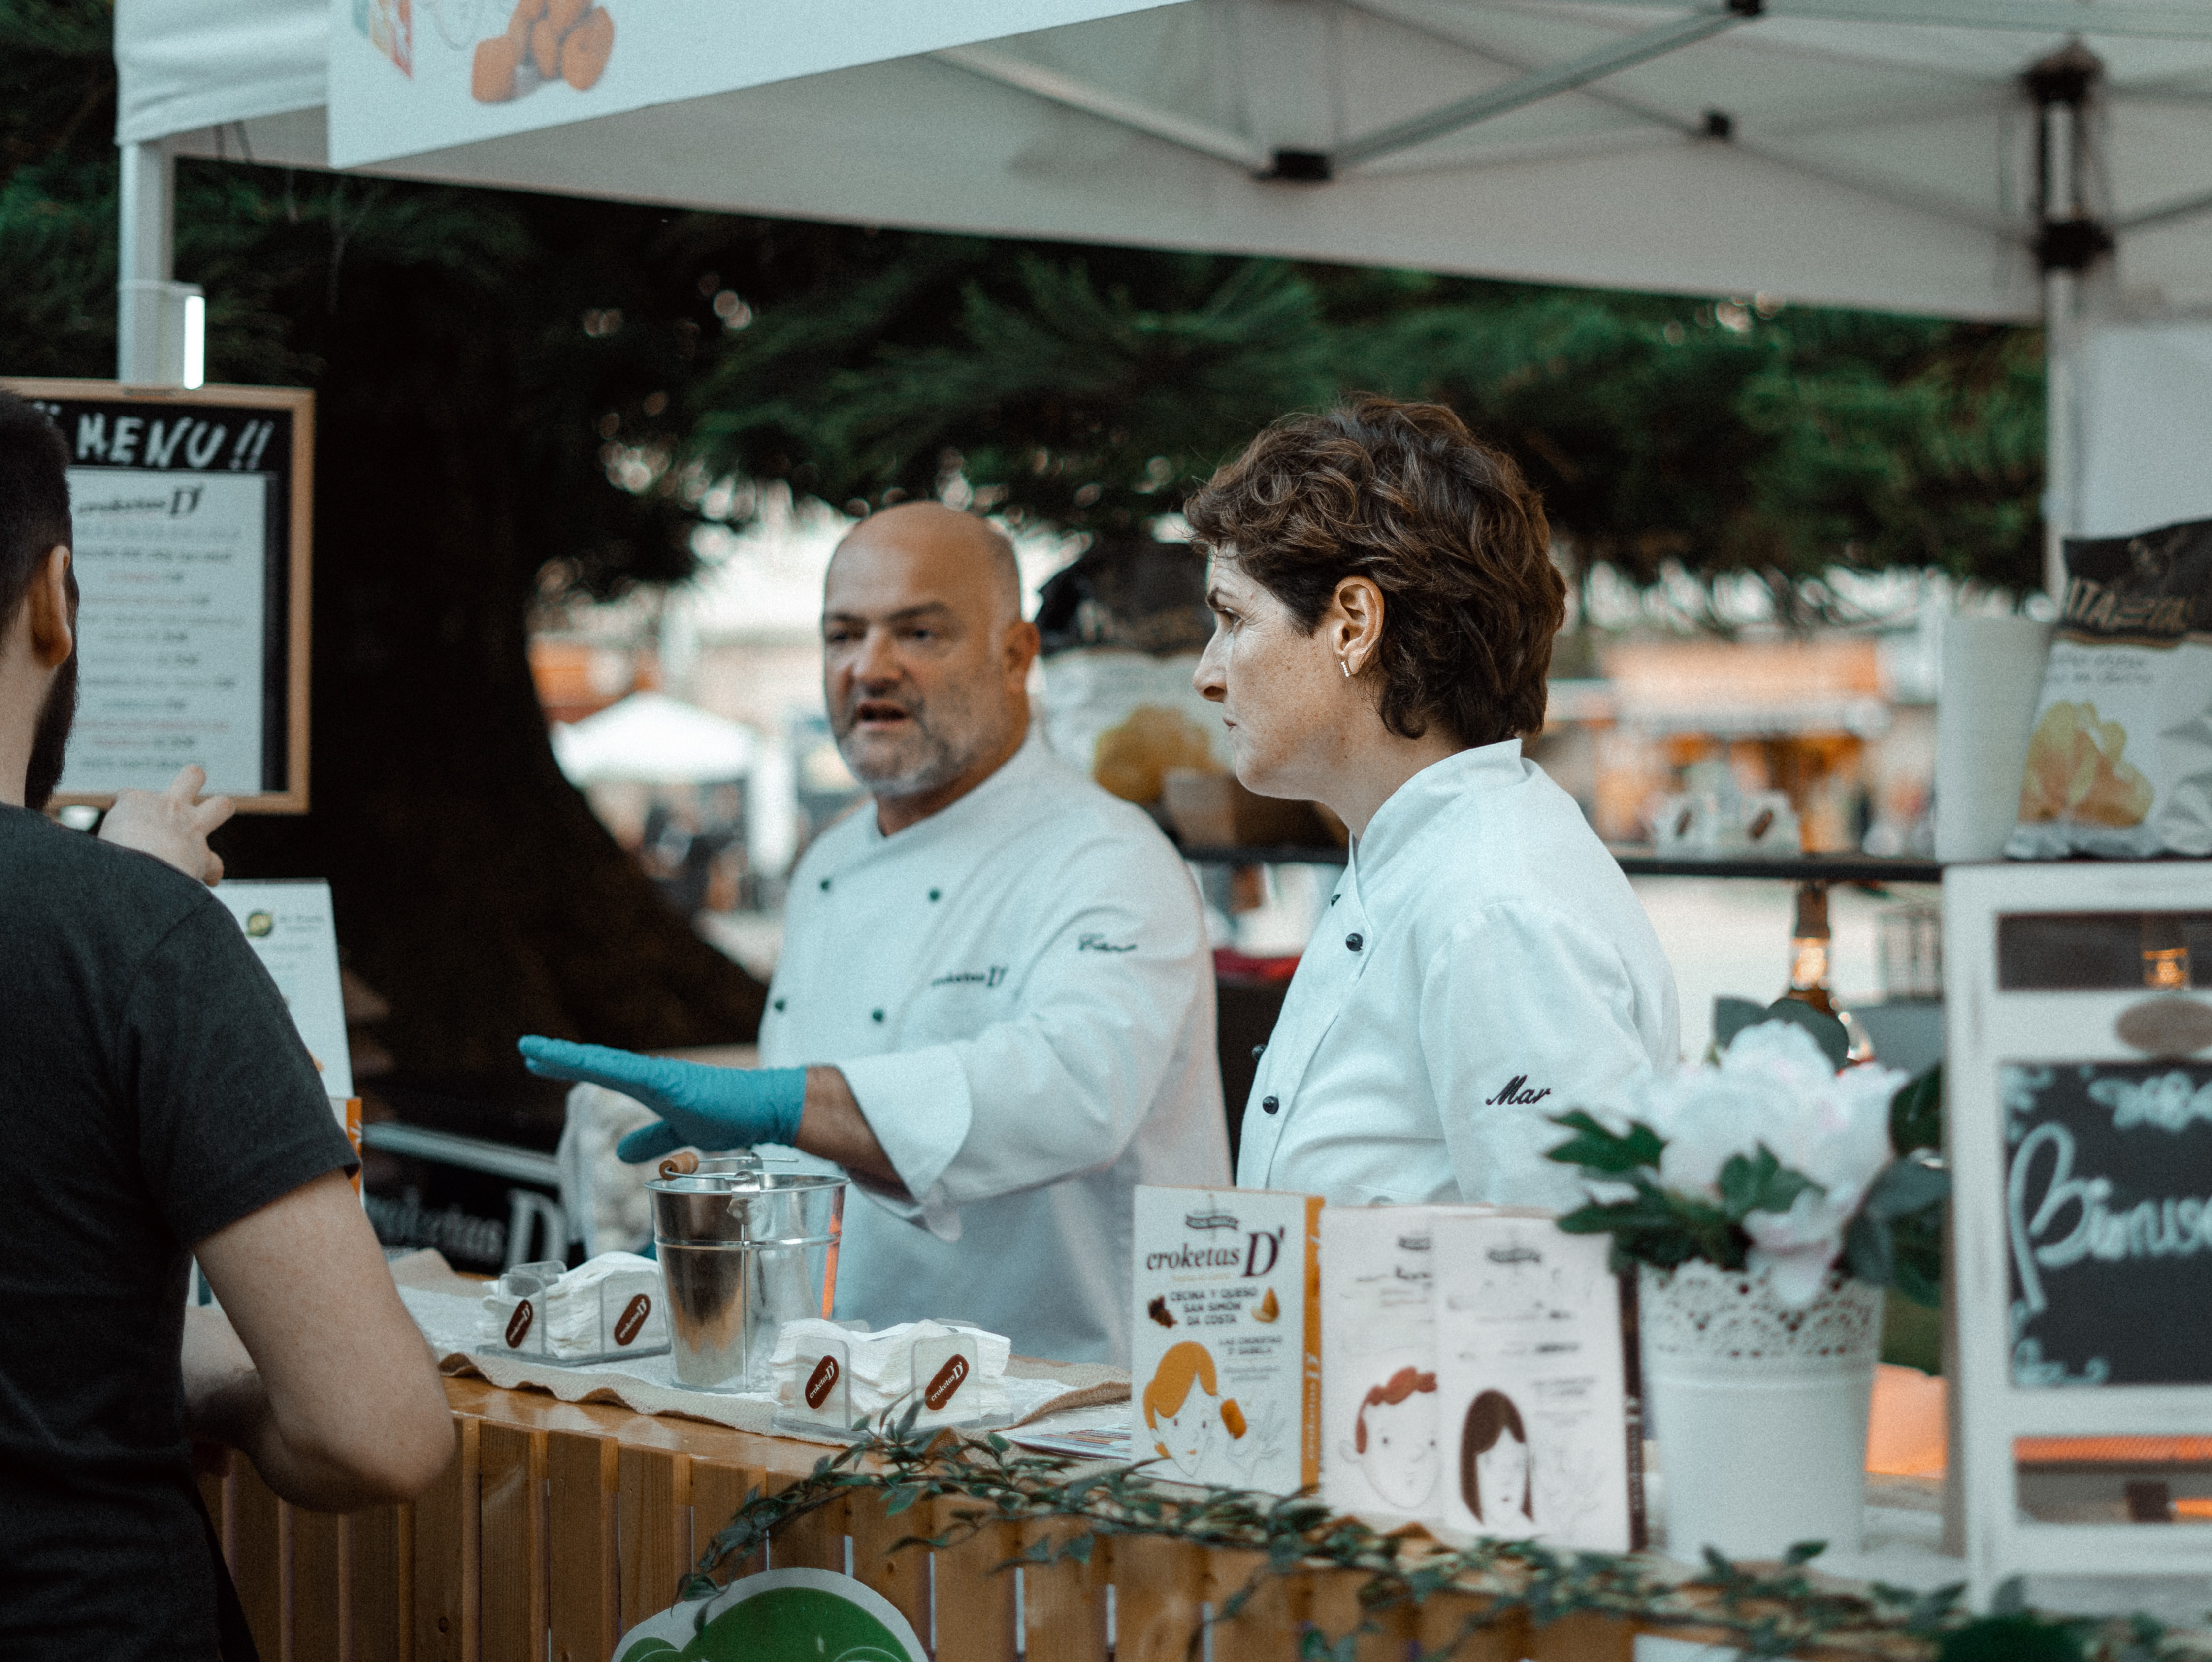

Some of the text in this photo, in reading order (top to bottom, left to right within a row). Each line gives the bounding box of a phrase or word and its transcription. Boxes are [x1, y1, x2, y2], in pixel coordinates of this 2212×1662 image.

[1485, 1074, 1551, 1105] Mar
[1146, 1242, 1240, 1270] croketas
[810, 1374, 828, 1398] croketas
[931, 1361, 963, 1401] croketas D'
